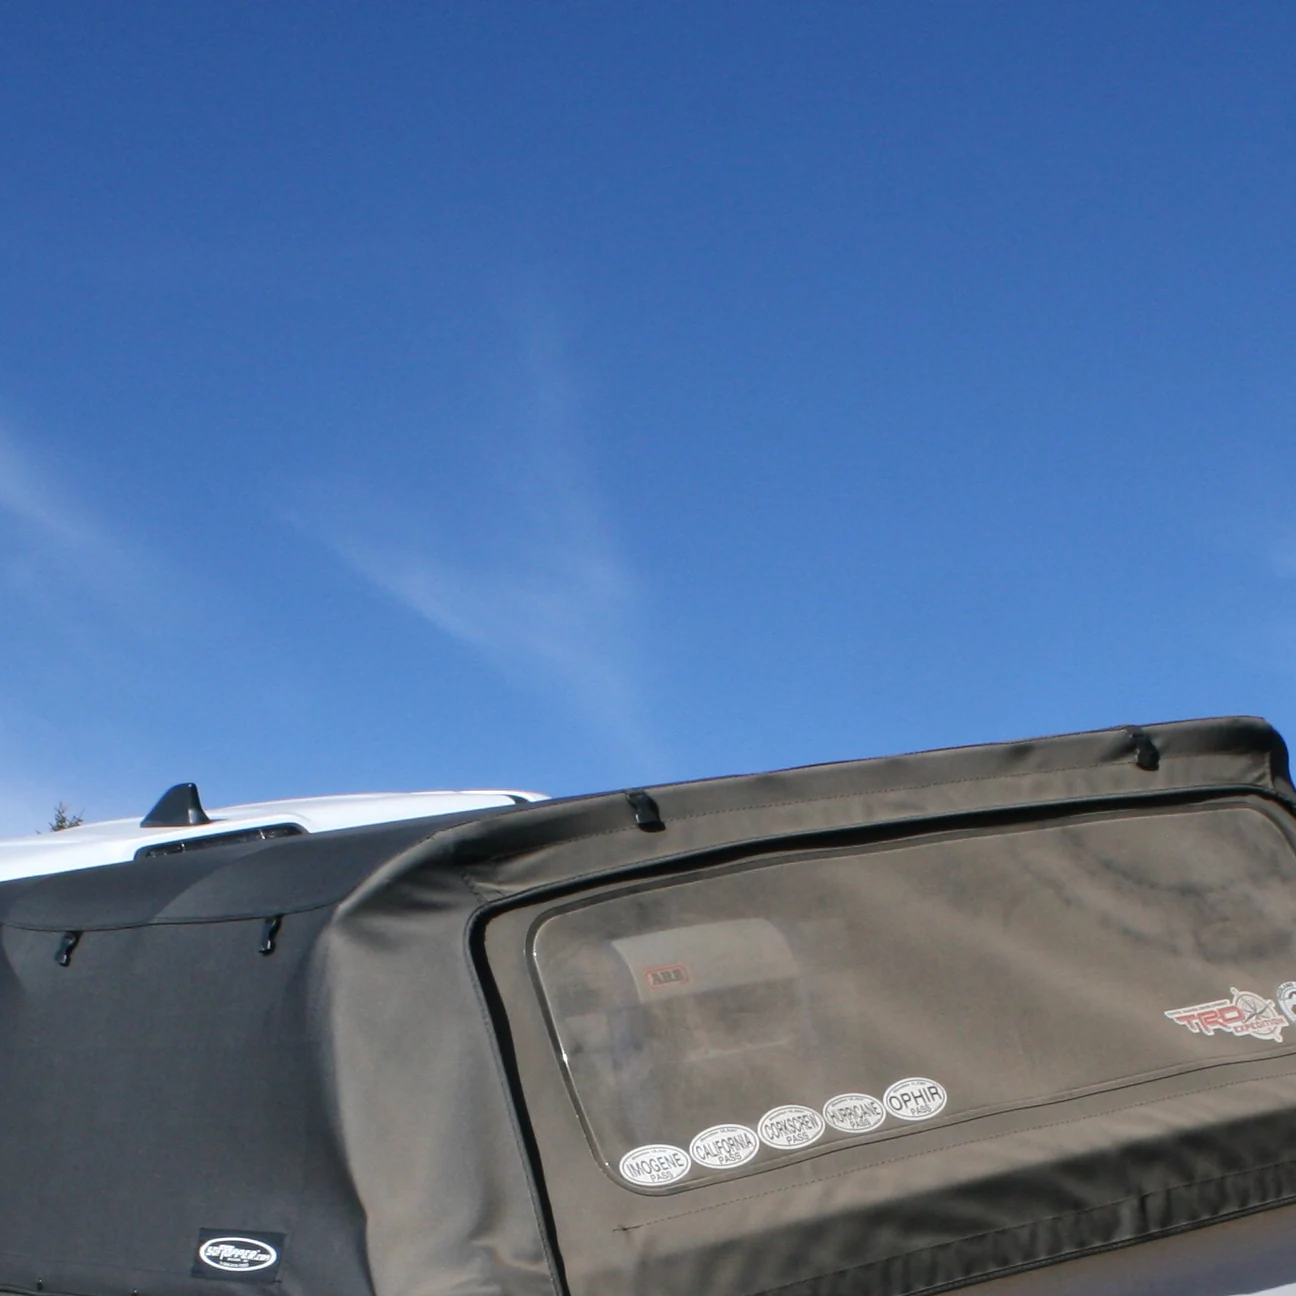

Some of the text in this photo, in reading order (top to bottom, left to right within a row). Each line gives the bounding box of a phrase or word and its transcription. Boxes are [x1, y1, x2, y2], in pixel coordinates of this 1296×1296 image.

[1176, 1005, 1245, 1033] TRD
[888, 1085, 942, 1111] OPHIR
[910, 1104, 932, 1116] PASS
[827, 1101, 881, 1125] HURRICANE
[850, 1117, 871, 1129] PASS
[764, 1113, 820, 1140] CORKSCREW
[786, 1132, 810, 1145] PASS
[695, 1133, 754, 1160] CALIFORNIA
[718, 1152, 742, 1165] PASS
[626, 1152, 685, 1178] IMOGENE
[650, 1170, 674, 1183] PASS
